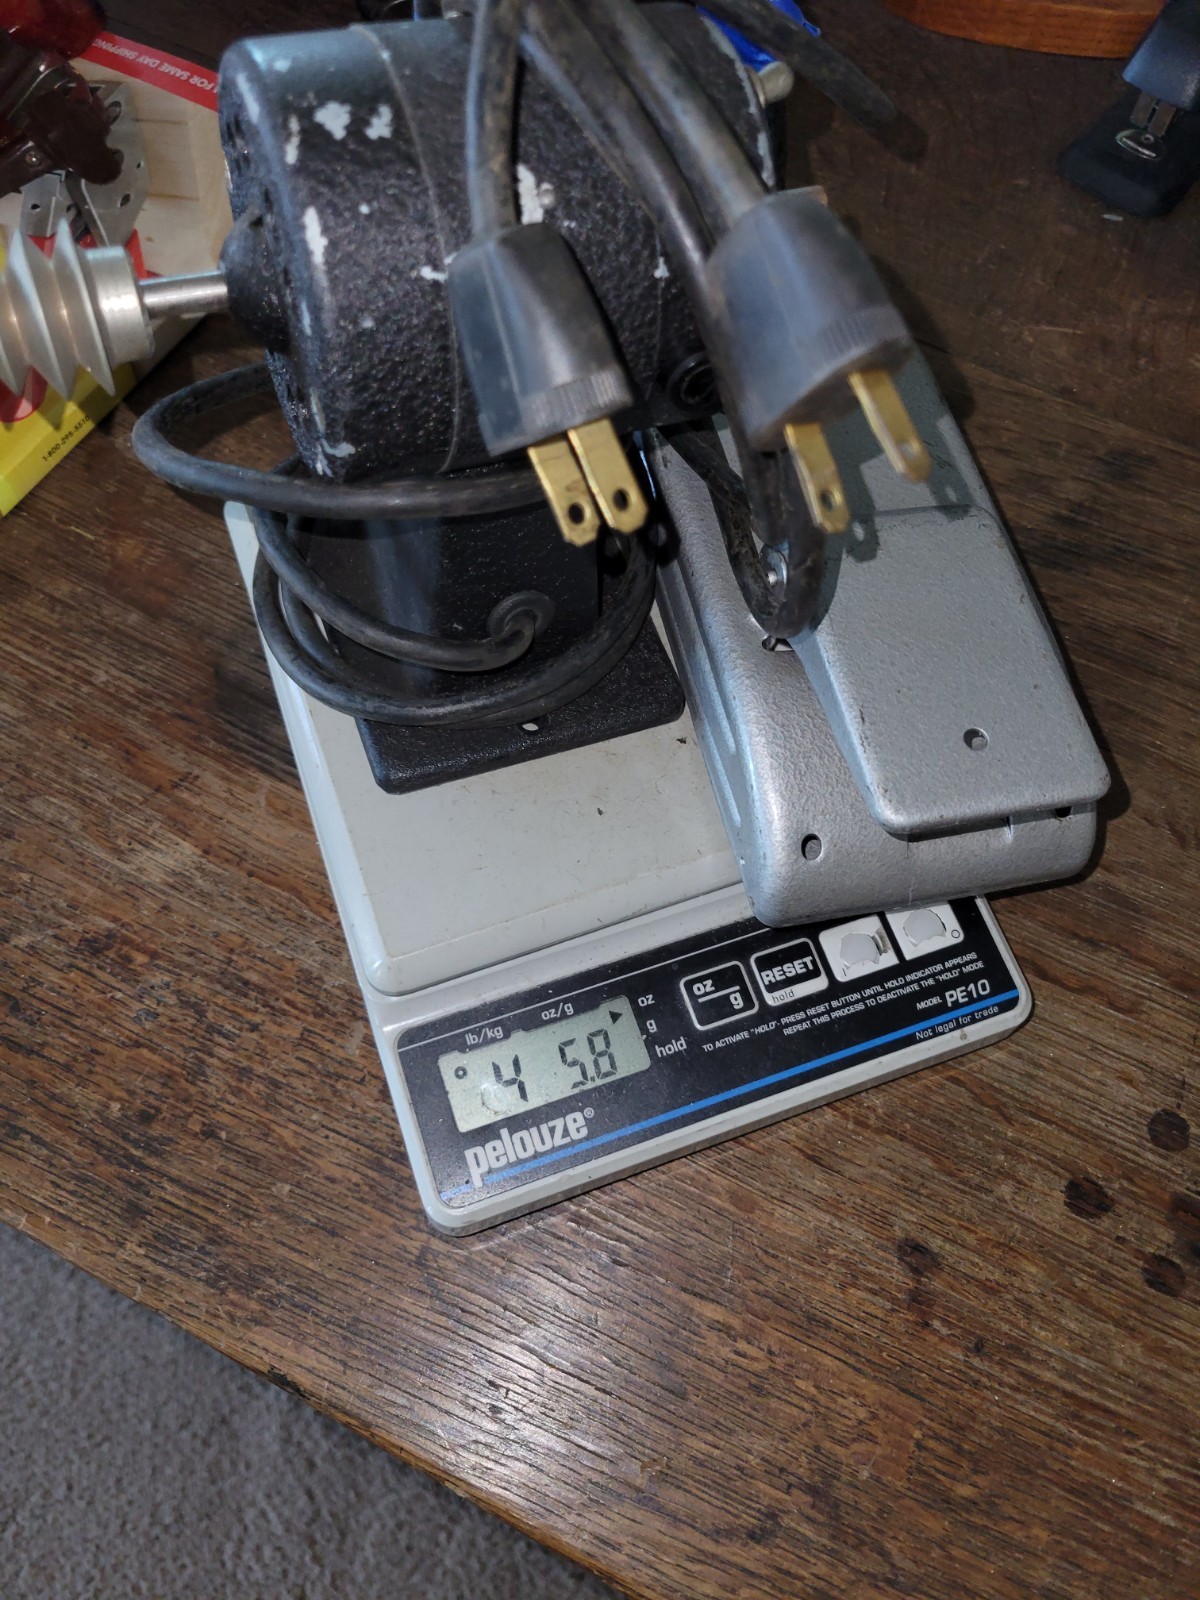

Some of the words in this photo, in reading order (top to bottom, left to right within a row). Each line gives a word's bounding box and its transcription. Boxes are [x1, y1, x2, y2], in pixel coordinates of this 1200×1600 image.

[91, 38, 138, 60] SHIPPING
[137, 55, 160, 69] DAY
[159, 62, 191, 80] SAME
[189, 74, 214, 91] FOR
[760, 956, 814, 986] RESET
[692, 979, 716, 996] oz
[771, 989, 795, 1004] hold
[916, 995, 943, 1011] MODEL
[945, 978, 991, 1008] PE10
[638, 993, 656, 1008] oz
[702, 1043, 714, 1053] TO
[715, 1030, 751, 1049] ACTIVATE
[780, 1011, 806, 1026] PRESS
[806, 1003, 831, 1018] RESET
[831, 993, 862, 1009] BUTTON
[862, 985, 884, 998] UNTIL
[884, 977, 905, 990] HOLD
[905, 963, 944, 983] INDICATOR
[944, 951, 978, 970] APPEARS
[729, 992, 744, 1010] g
[783, 1021, 812, 1037] REPEAT
[812, 1014, 830, 1027] THIS
[831, 1003, 865, 1021] PROCESS
[865, 997, 877, 1007] TO
[876, 982, 921, 1004] DEACTIVATE
[920, 977, 936, 989] THE
[962, 960, 985, 974] MODE
[541, 1002, 574, 1021] oz/g
[646, 1019, 658, 1034] g
[915, 1028, 934, 1041] Not
[935, 1019, 957, 1035] legal
[958, 1014, 972, 1027] for
[974, 1005, 1000, 1020] trade
[465, 1025, 504, 1046] lb/kg
[655, 1036, 688, 1058] hold
[491, 1053, 530, 1103] 4
[558, 1028, 618, 1090] 5.8
